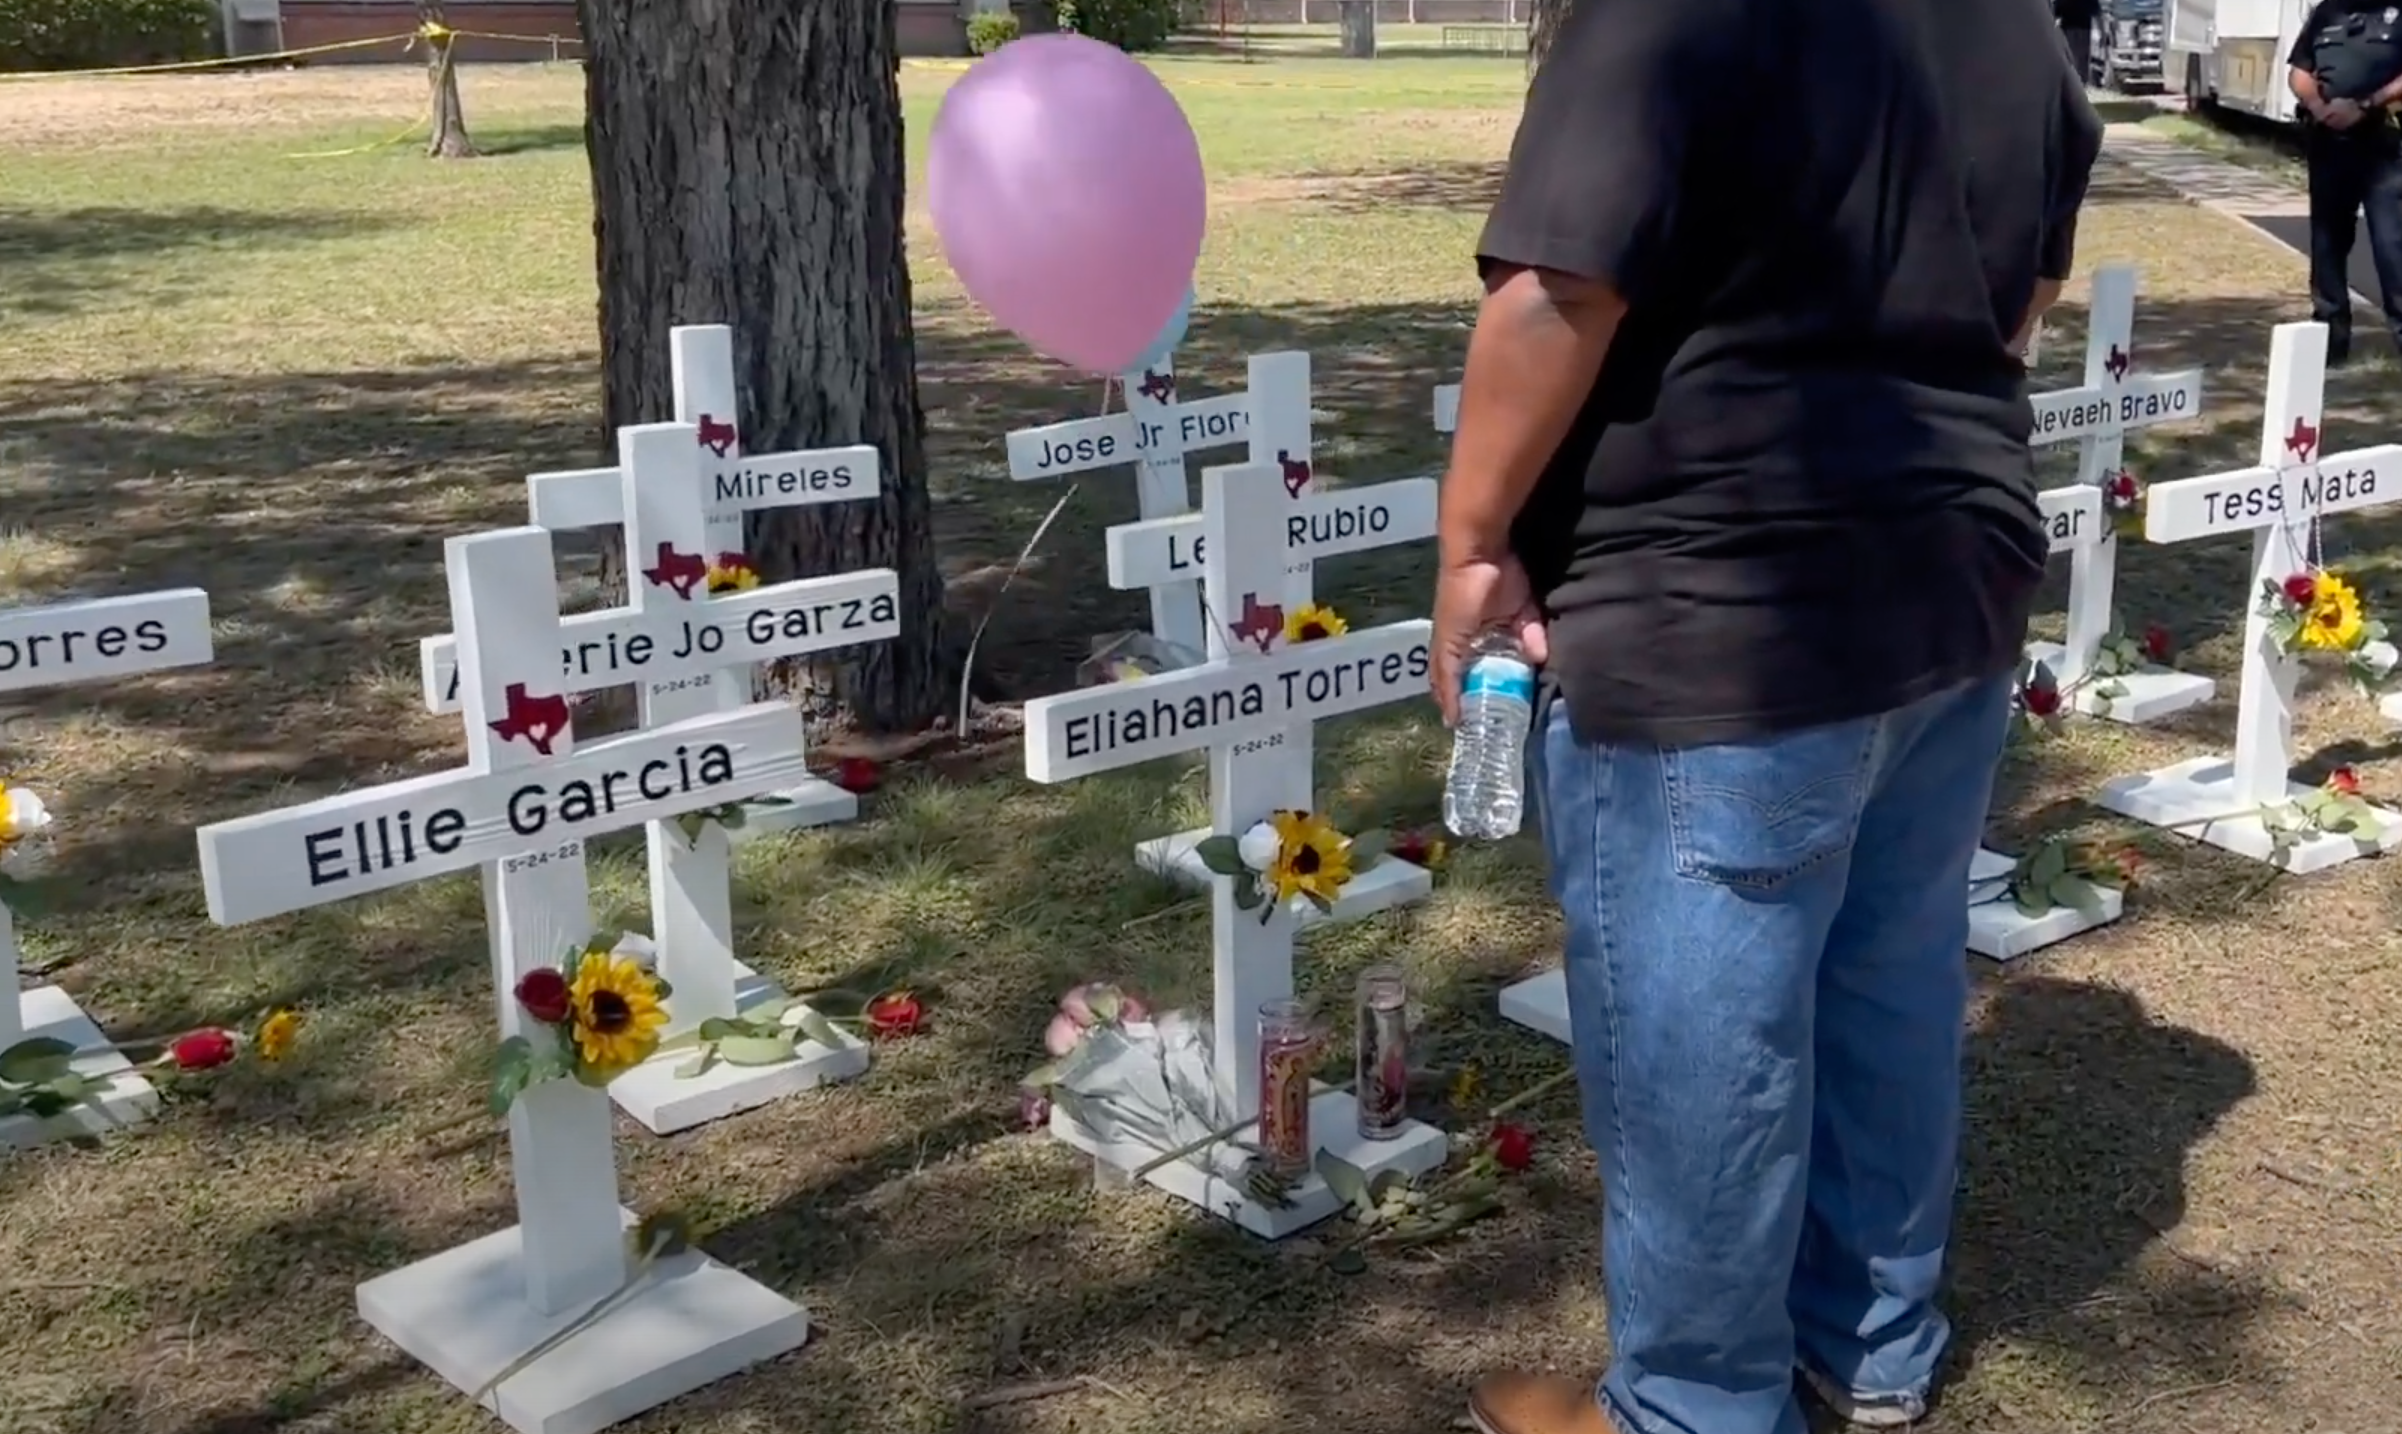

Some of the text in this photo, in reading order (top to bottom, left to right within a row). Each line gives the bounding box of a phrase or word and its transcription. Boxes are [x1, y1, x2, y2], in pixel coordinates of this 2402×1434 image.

[2121, 389, 2186, 422] Bravo
[1038, 411, 1249, 469] Jose Jr Flor
[715, 465, 852, 501] Mireles
[2204, 469, 2376, 524] Tess Mata
[1288, 505, 1389, 547] Rubio
[672, 621, 723, 658] Jo
[747, 594, 896, 644] Garza
[652, 674, 712, 695] 5-24-22
[1066, 644, 1429, 759] Eliahana Torres
[1234, 733, 1284, 756] 5-24-22
[305, 742, 733, 887] Ellie Garcia
[506, 843, 581, 874] 5-24-22
